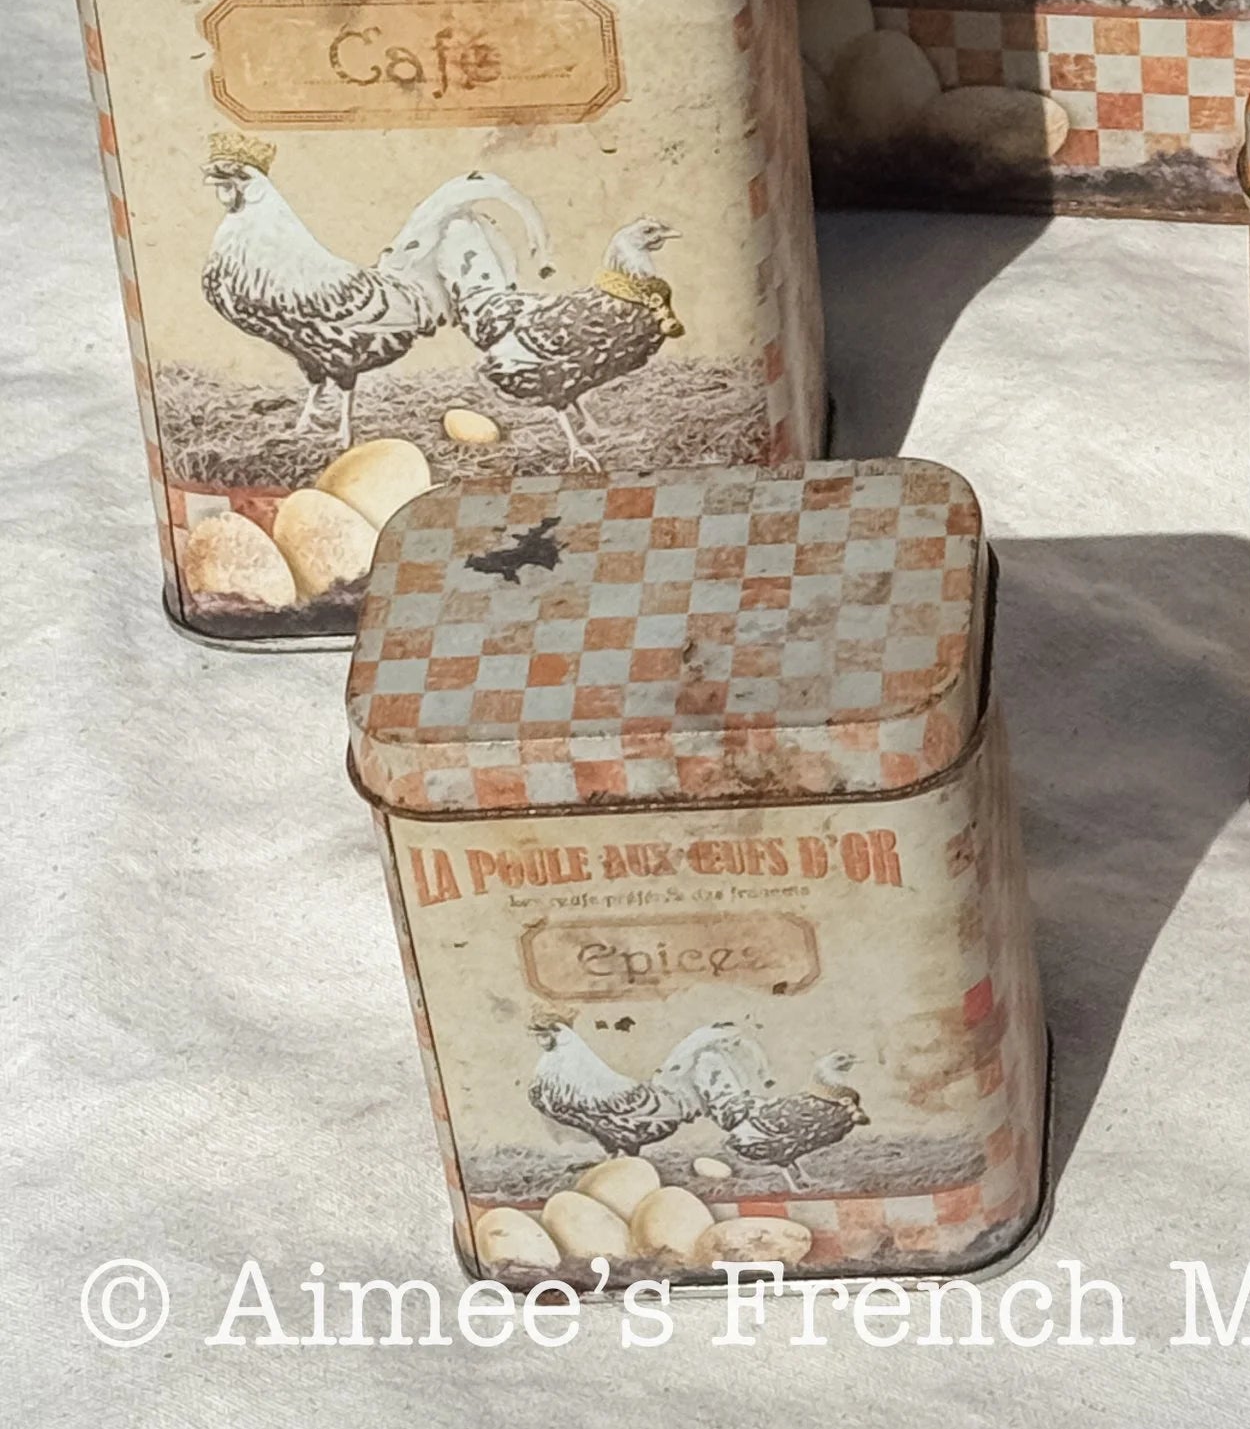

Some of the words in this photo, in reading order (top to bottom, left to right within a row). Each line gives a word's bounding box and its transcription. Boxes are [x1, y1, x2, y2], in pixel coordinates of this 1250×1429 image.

[410, 846, 461, 907] LA
[464, 846, 592, 895] POULE
[601, 842, 679, 879] AUX
[799, 828, 904, 888] D'OR
